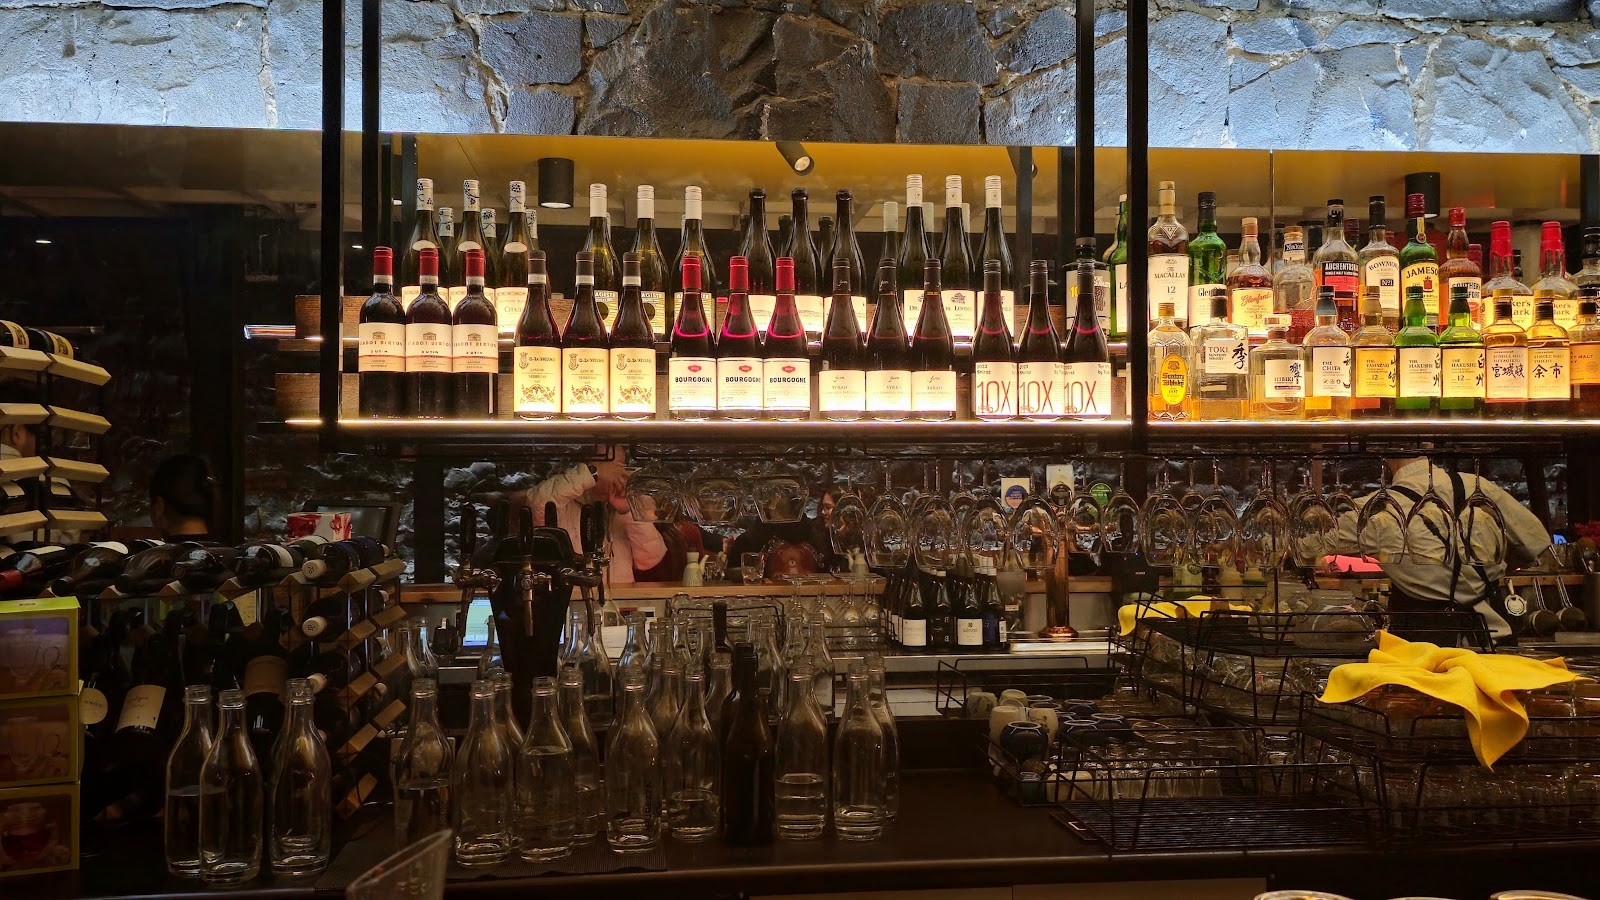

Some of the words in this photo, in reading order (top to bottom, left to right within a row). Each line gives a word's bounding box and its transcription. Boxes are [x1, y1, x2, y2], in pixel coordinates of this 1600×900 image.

[1406, 267, 1438, 279] JAMESO
[1167, 286, 1176, 294] 12
[1512, 300, 1531, 308] ker's
[1513, 308, 1530, 316] ark
[1231, 342, 1248, 370] 季
[1532, 362, 1563, 379] 余市
[1162, 373, 1184, 381] Suntory
[1162, 379, 1184, 388] Whisky
[977, 380, 1011, 413] 10X
[1019, 380, 1053, 413] 10X
[1064, 380, 1097, 413] 10X
